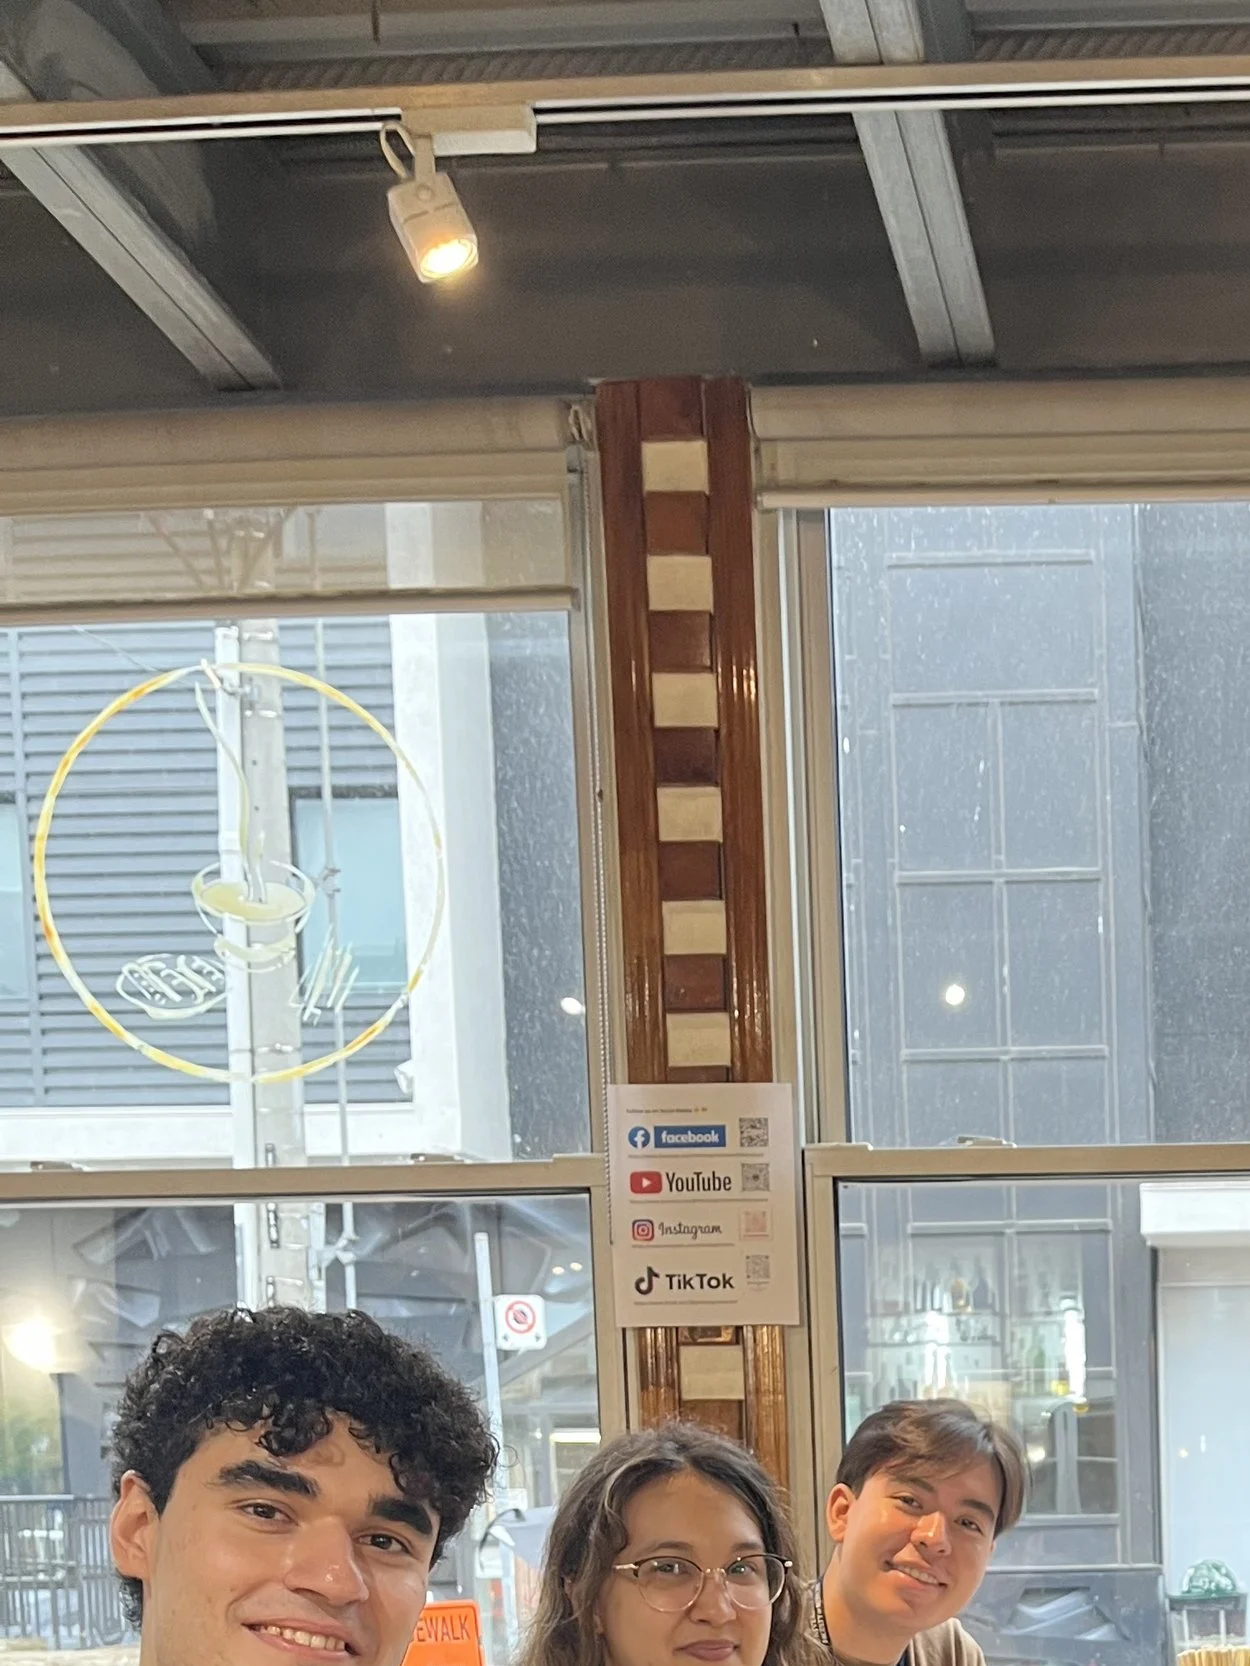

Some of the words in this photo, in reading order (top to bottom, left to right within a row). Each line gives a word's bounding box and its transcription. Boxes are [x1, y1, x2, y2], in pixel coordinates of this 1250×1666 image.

[661, 1129, 720, 1143] facebook
[666, 1171, 732, 1193] YouTube
[658, 1222, 722, 1239] Instagram
[666, 1273, 735, 1290] TikTok
[416, 1614, 471, 1642] EWALK
